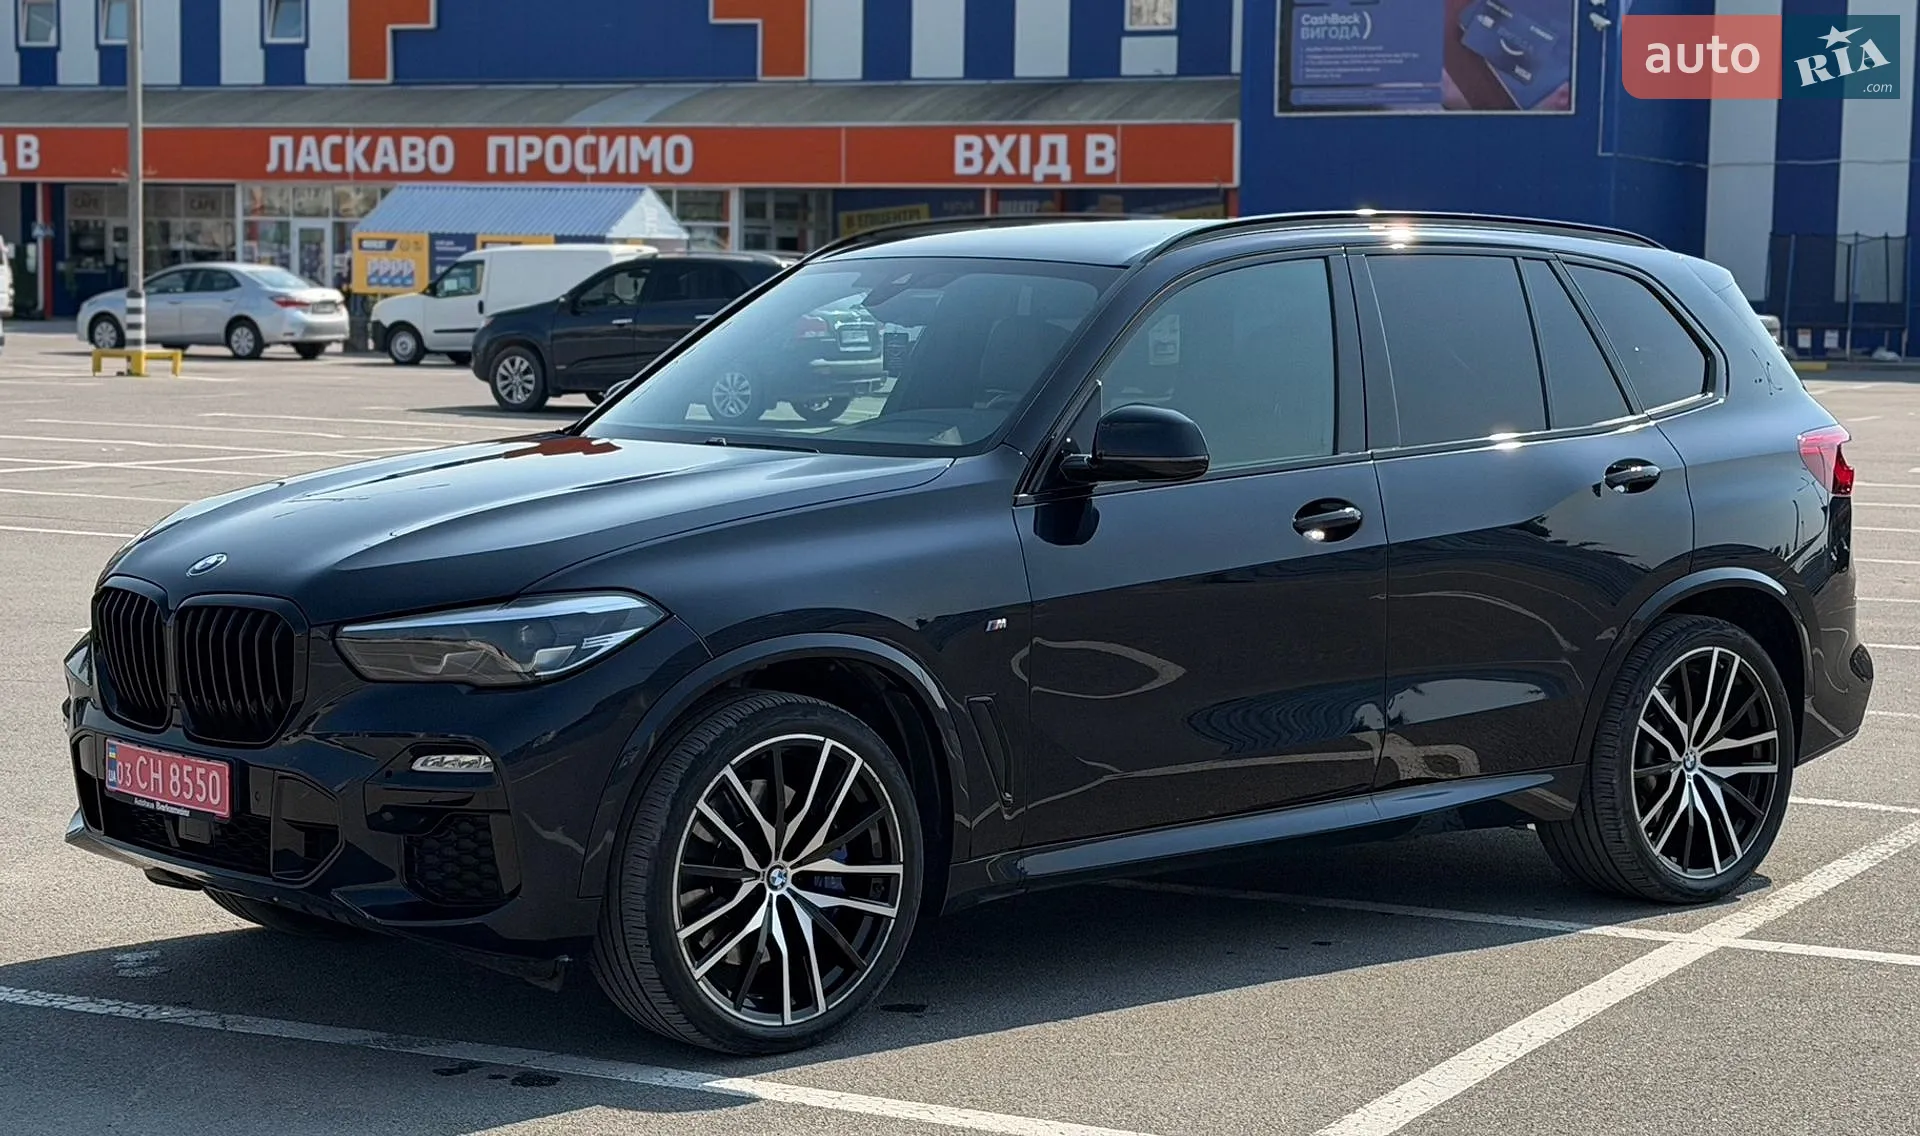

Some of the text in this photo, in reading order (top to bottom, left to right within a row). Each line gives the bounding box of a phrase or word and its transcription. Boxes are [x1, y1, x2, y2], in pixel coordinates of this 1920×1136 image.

[1301, 11, 1361, 26] CashBack
[1301, 25, 1361, 40] ВИГОДА
[16, 133, 40, 170] В
[266, 134, 694, 175] ЛАСКАВО ПРОСИМО
[953, 133, 1117, 182] ВХІД В
[116, 755, 221, 805] 03 CH 8550
